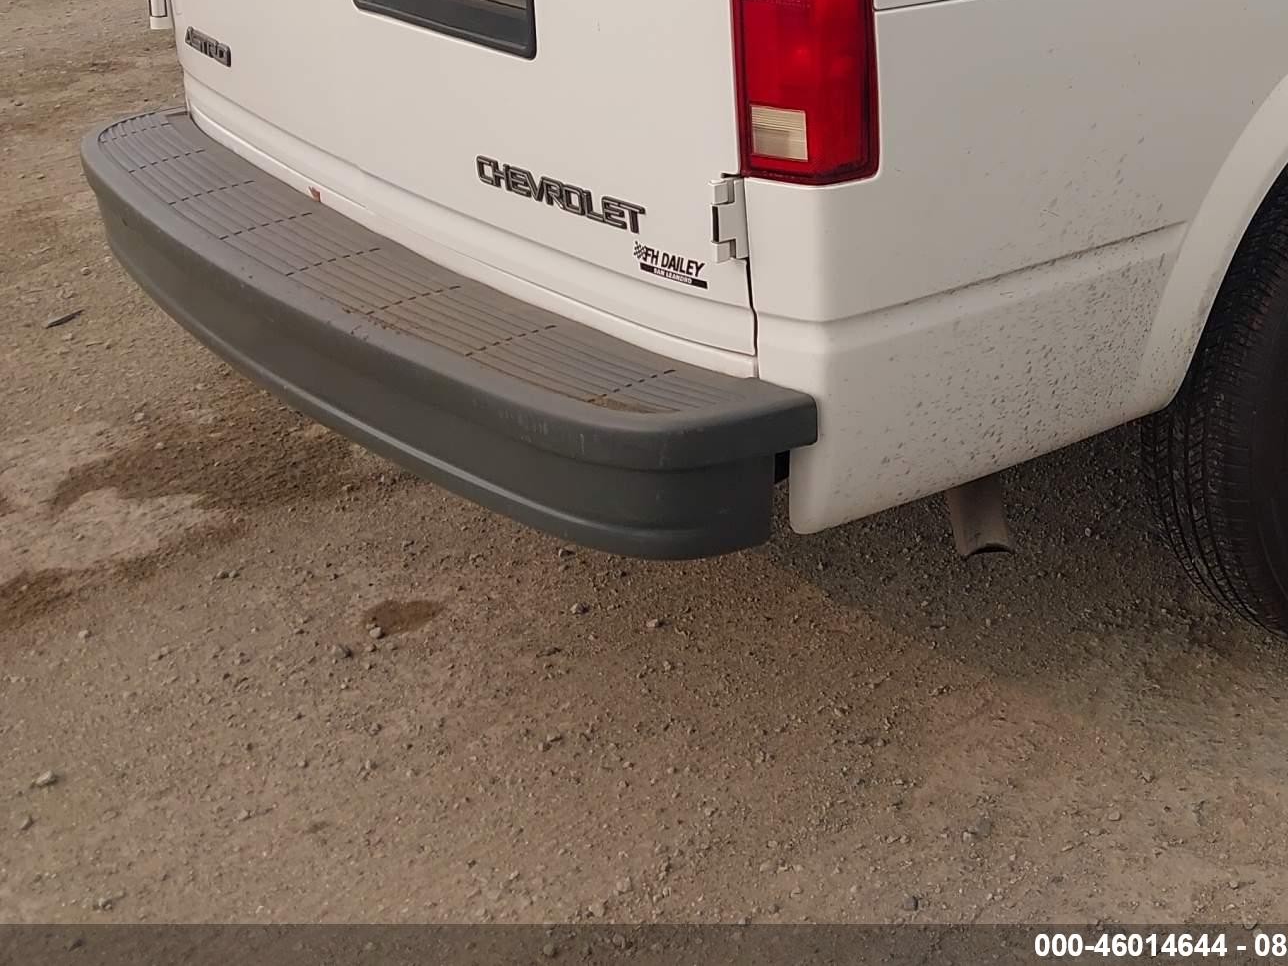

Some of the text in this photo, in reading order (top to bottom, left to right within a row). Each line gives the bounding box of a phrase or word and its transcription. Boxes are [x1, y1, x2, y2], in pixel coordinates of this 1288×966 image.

[185, 26, 232, 68] ASTRO
[476, 155, 646, 234] CHEVROLET
[643, 246, 706, 278] FH DAILEY
[653, 268, 666, 277] SAN
